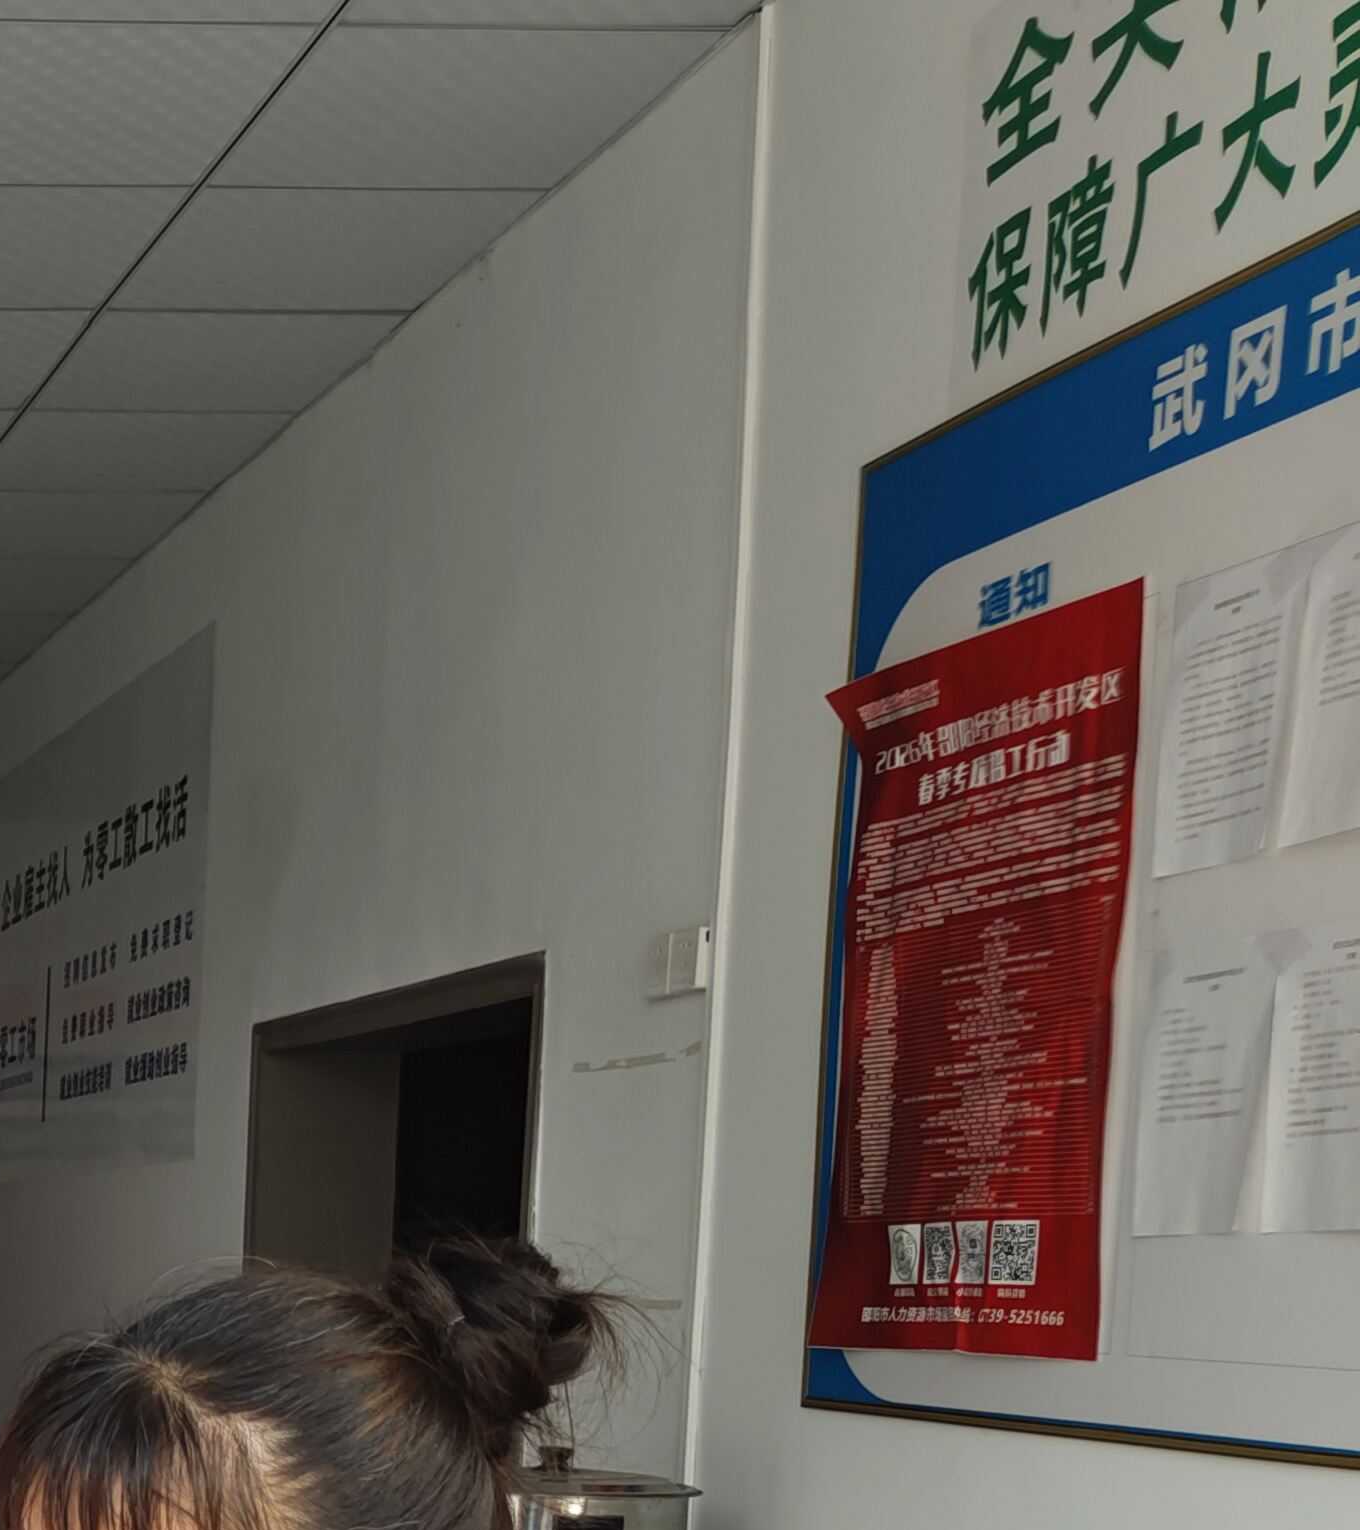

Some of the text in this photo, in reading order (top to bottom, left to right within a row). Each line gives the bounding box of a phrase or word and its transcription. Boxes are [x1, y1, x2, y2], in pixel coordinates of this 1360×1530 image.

[1147, 267, 1360, 453] 武冈市
[976, 561, 1052, 628] 通知
[81, 775, 190, 891] 为零工散工找活
[129, 909, 194, 963] 免费求职登记
[0, 1016, 37, 1069] 零工市场
